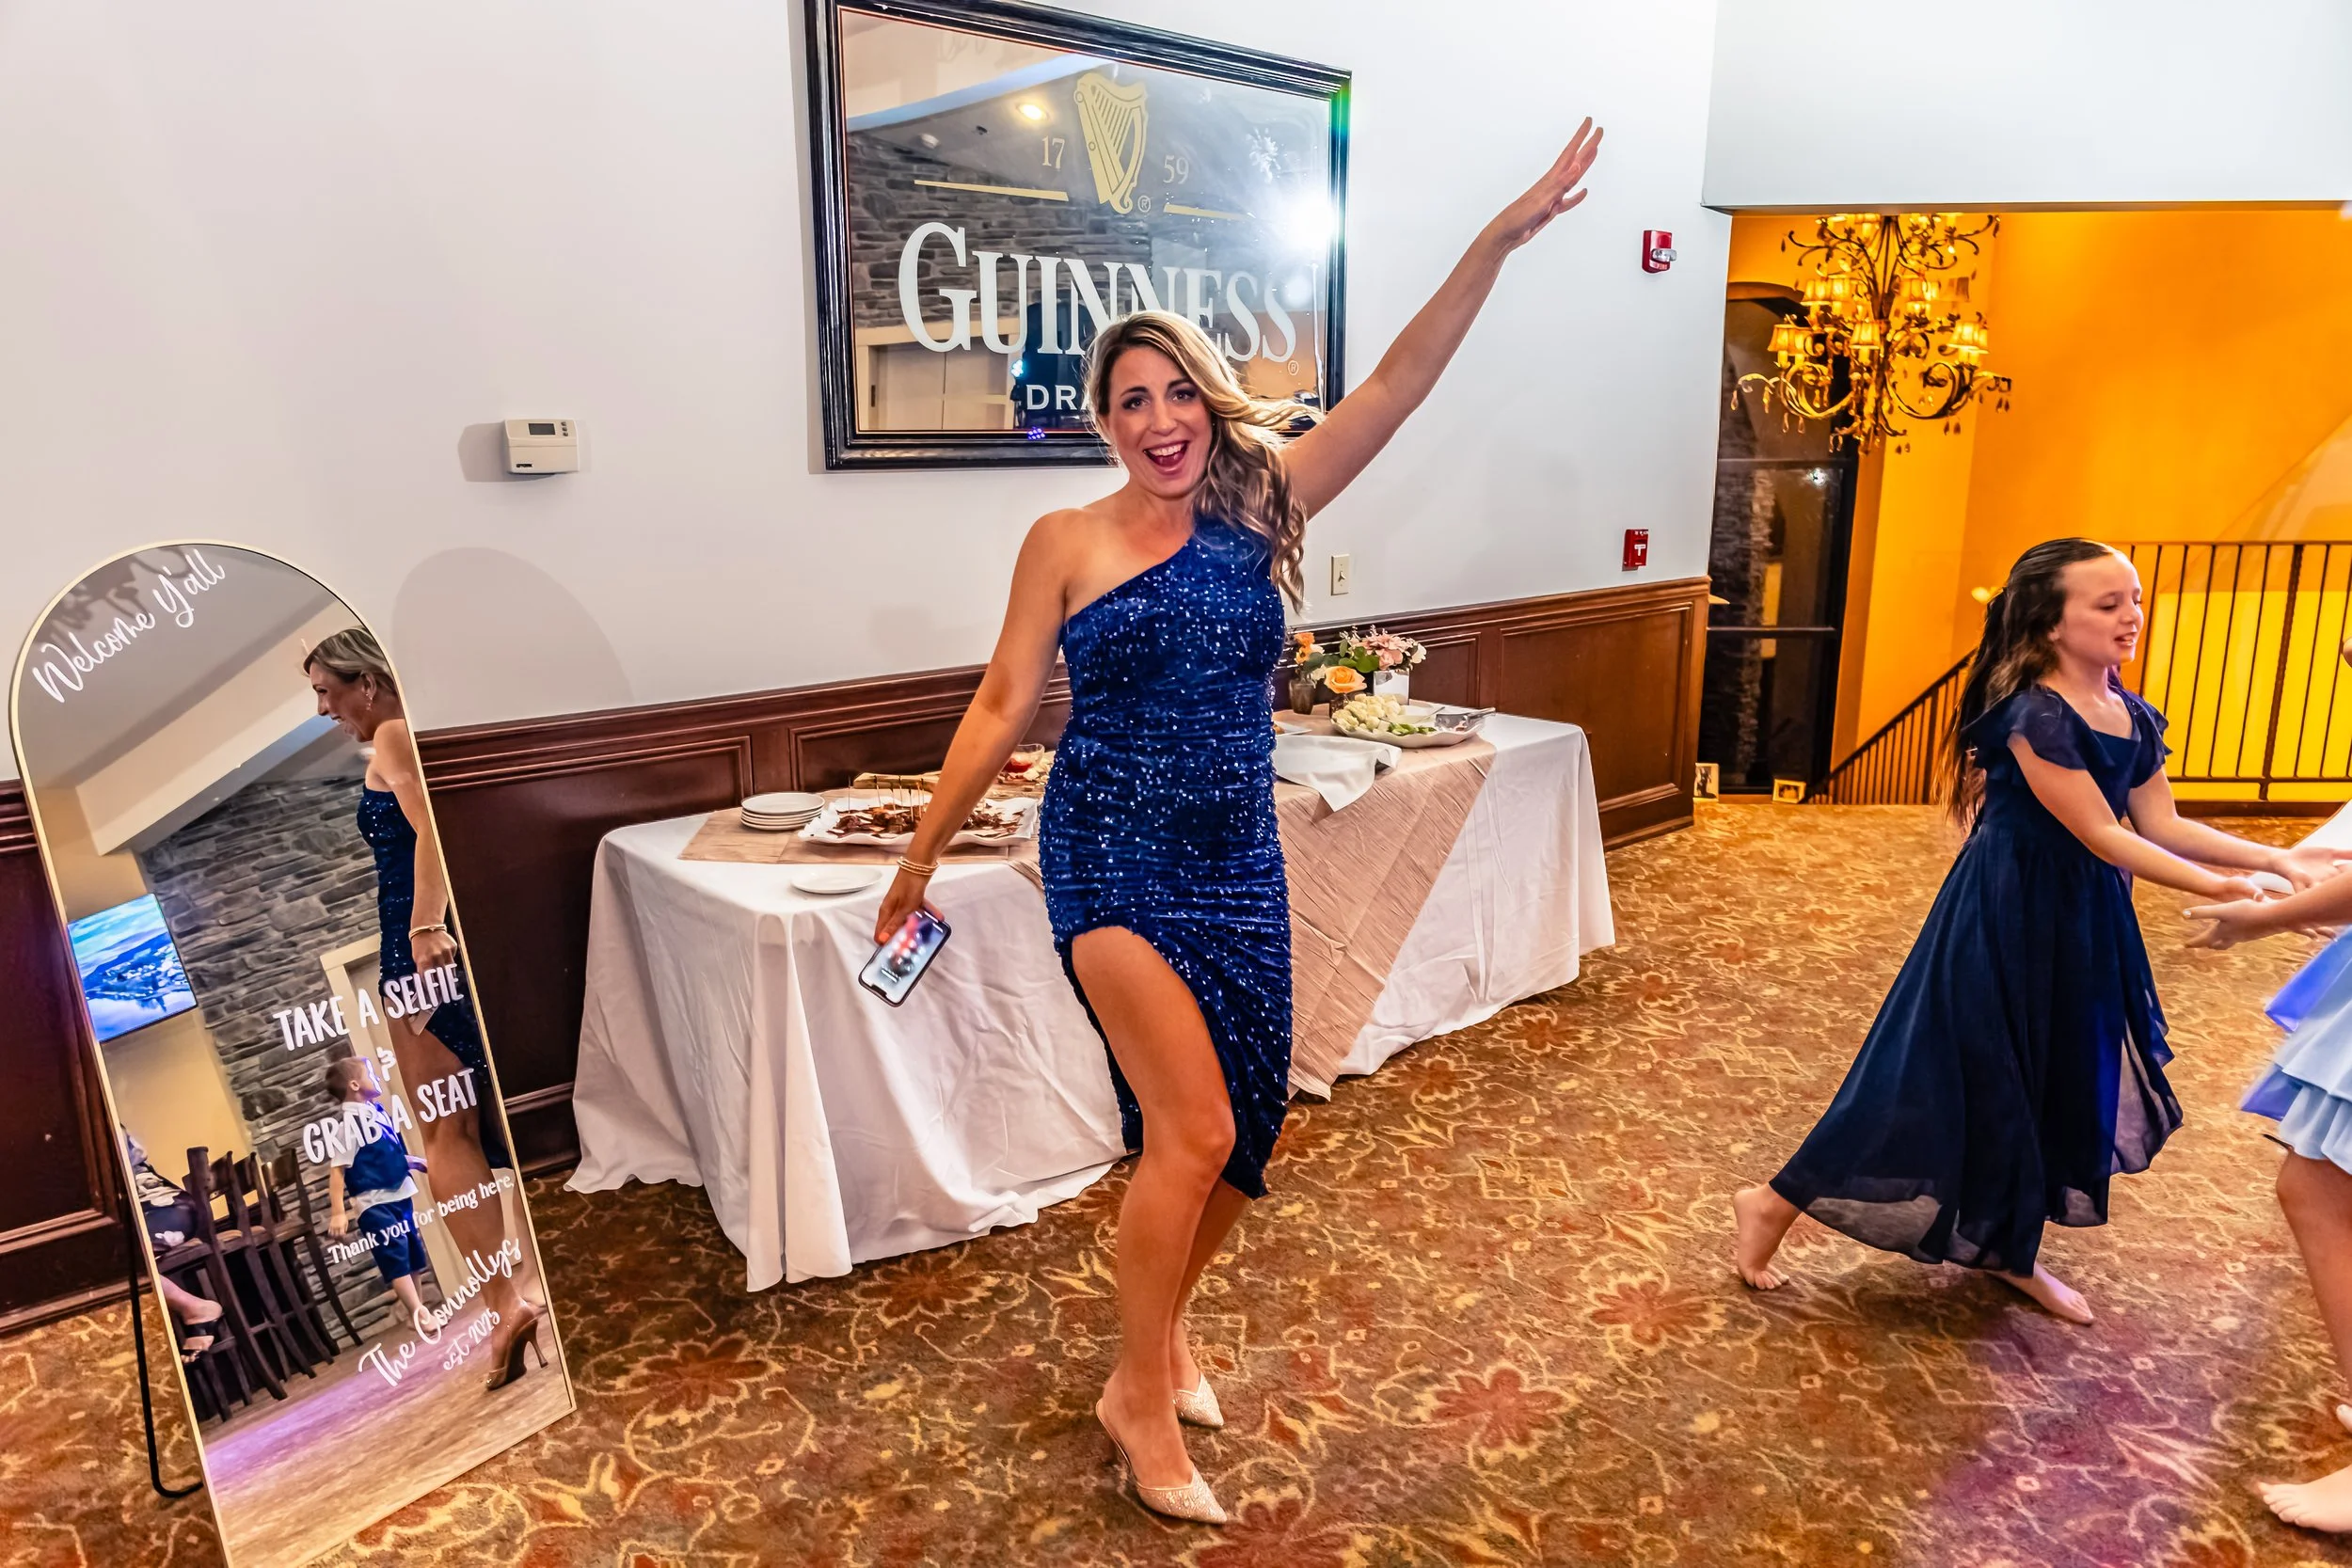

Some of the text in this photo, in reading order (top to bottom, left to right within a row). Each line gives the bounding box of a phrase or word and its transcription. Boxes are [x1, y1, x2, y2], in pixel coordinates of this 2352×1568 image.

[1041, 135, 1066, 170] 17
[1163, 153, 1190, 186] 59
[32, 611, 155, 704] Welcome
[273, 962, 465, 1052] TAKE A SELFIE
[302, 1068, 479, 1164] GRAB A SEAT
[327, 1231, 380, 1264] Thank
[380, 1218, 411, 1246] you
[412, 1207, 436, 1229] for
[437, 1188, 479, 1217] being
[358, 1342, 416, 1387] The
